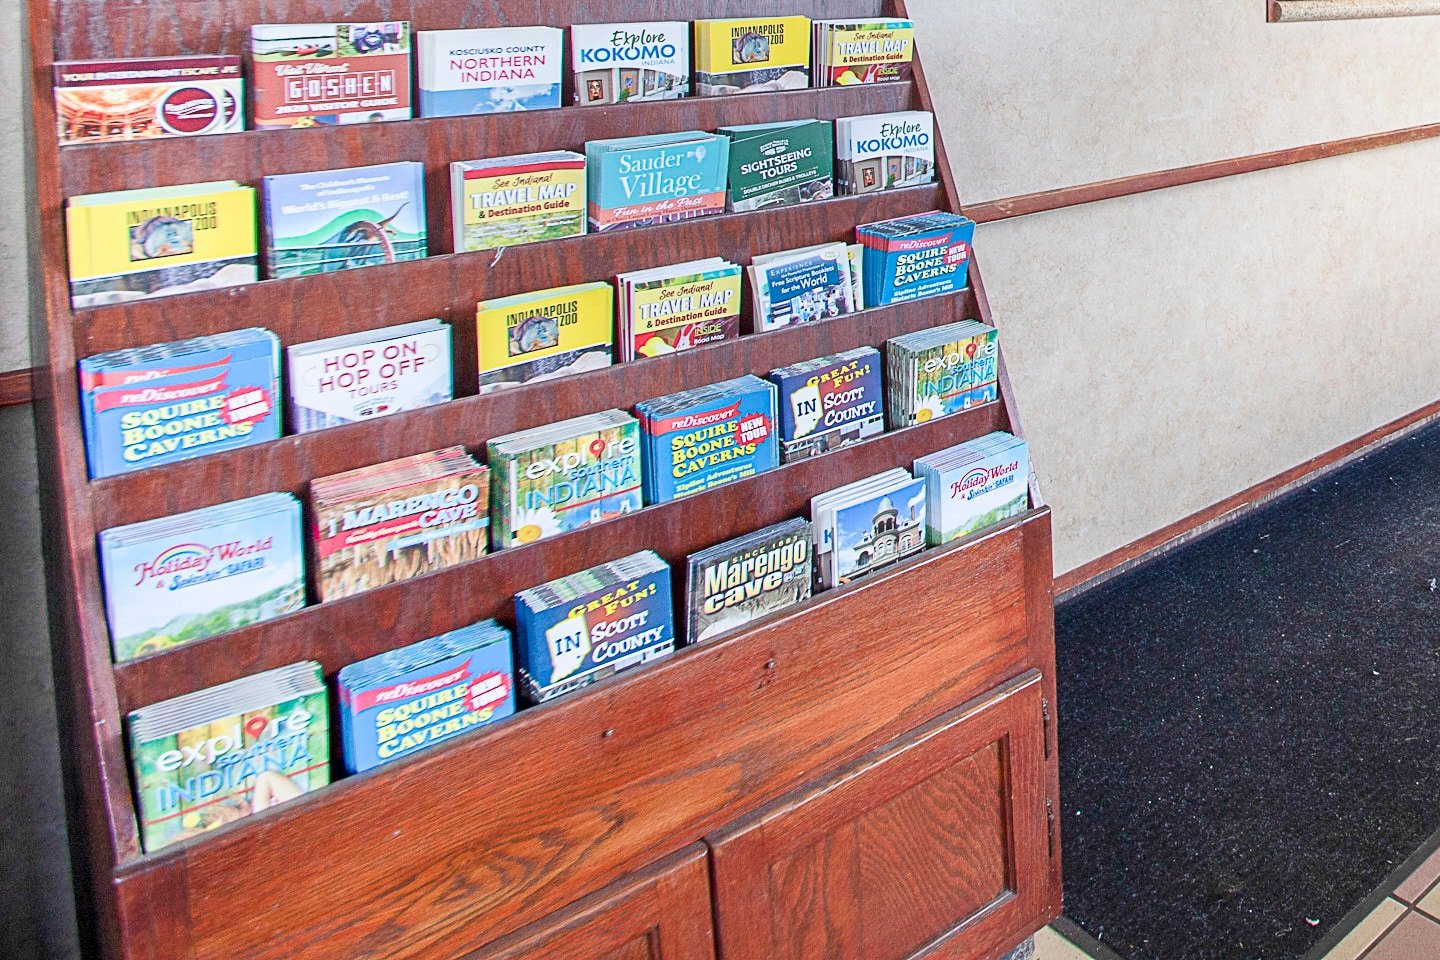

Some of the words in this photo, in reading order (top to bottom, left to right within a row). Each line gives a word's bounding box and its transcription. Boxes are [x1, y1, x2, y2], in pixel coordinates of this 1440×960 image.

[450, 47, 504, 56] KOSCIUSKO
[506, 45, 546, 54] COUNTY
[610, 29, 666, 50] Explore
[838, 40, 882, 56] TRAVEL
[884, 40, 908, 52] MAP
[450, 54, 546, 70] NORTHERN
[580, 44, 676, 63] KOKOMO
[642, 58, 675, 66] INDIANA
[850, 54, 885, 62] Destination
[461, 68, 535, 82] INDIANA
[880, 121, 922, 140] Explore
[857, 133, 929, 154] KOKOMO
[618, 150, 684, 175] Sauder
[741, 148, 812, 174] SIGHTSEEING
[760, 162, 798, 180] TOURS
[513, 173, 552, 188] Indiana!
[620, 172, 700, 200] Village
[470, 187, 536, 210] TRAVEL
[538, 182, 578, 200] MAP
[127, 202, 217, 226] INDIANAPOLIS
[488, 203, 542, 218] Destination
[544, 200, 570, 212] Guide
[614, 208, 638, 218] Fun
[193, 216, 217, 231] ZOO
[896, 246, 948, 264] SQUIRE
[900, 236, 948, 250] reDiscover
[948, 244, 966, 256] NEW
[770, 261, 812, 276] EXPERIENCE
[896, 258, 944, 276] BOONE
[947, 251, 966, 264] TOUR
[772, 280, 785, 288] Free
[800, 273, 828, 288] World
[894, 264, 956, 287] CAVERNS
[660, 288, 678, 300] See
[680, 282, 714, 296] Indiana!
[507, 301, 578, 326] INDIANAPOLIS
[640, 298, 694, 320] TRAVEL
[700, 288, 734, 308] MAP
[655, 311, 702, 326] Destination
[704, 306, 728, 316] Guide
[560, 312, 578, 328] ZOO
[324, 349, 376, 374] HOP
[383, 340, 418, 362] ON
[952, 355, 994, 374] southern
[318, 366, 378, 394] HOP
[383, 356, 426, 378] OFF
[806, 360, 859, 388] GREAT
[833, 364, 870, 389] FUN!
[923, 366, 995, 398] INDIANA
[349, 379, 398, 398] TOURS
[823, 387, 864, 410] SCOTT
[120, 396, 224, 431] SQUIRE
[671, 408, 734, 430] reDiscover
[797, 398, 817, 416] IN
[824, 401, 876, 426] COUNTY
[122, 413, 222, 446] BOONE
[671, 421, 738, 450] SQUIRE
[740, 416, 764, 432] NEW
[740, 426, 768, 444] TOUR
[122, 423, 252, 462] CAVERNS
[672, 436, 734, 465] BOONE
[570, 454, 635, 480] southern
[672, 443, 756, 478] CAVERNS
[706, 463, 752, 482] Adventures
[526, 470, 636, 510] INDIANA
[950, 474, 989, 498] Holiday
[988, 460, 1018, 478] World
[995, 474, 1014, 488] SAFARI
[342, 484, 479, 530] MARENGO
[419, 502, 478, 528] CAVE
[134, 555, 213, 586] Holiday
[210, 536, 272, 560] World
[732, 548, 766, 564] SINCE
[772, 535, 799, 548] 1883
[704, 538, 808, 598] Marengo
[568, 580, 640, 618] GREAT
[604, 583, 657, 617] FUN!
[704, 571, 783, 615] cave
[592, 610, 650, 642] SCOTT
[555, 632, 581, 656] IN
[592, 626, 664, 663] COUNTY
[376, 669, 466, 702] reDiscover
[376, 682, 468, 727] SQUIRE
[376, 700, 463, 742] BOONE
[376, 707, 494, 760] CAVERNS
[156, 744, 312, 811] INDIANA
